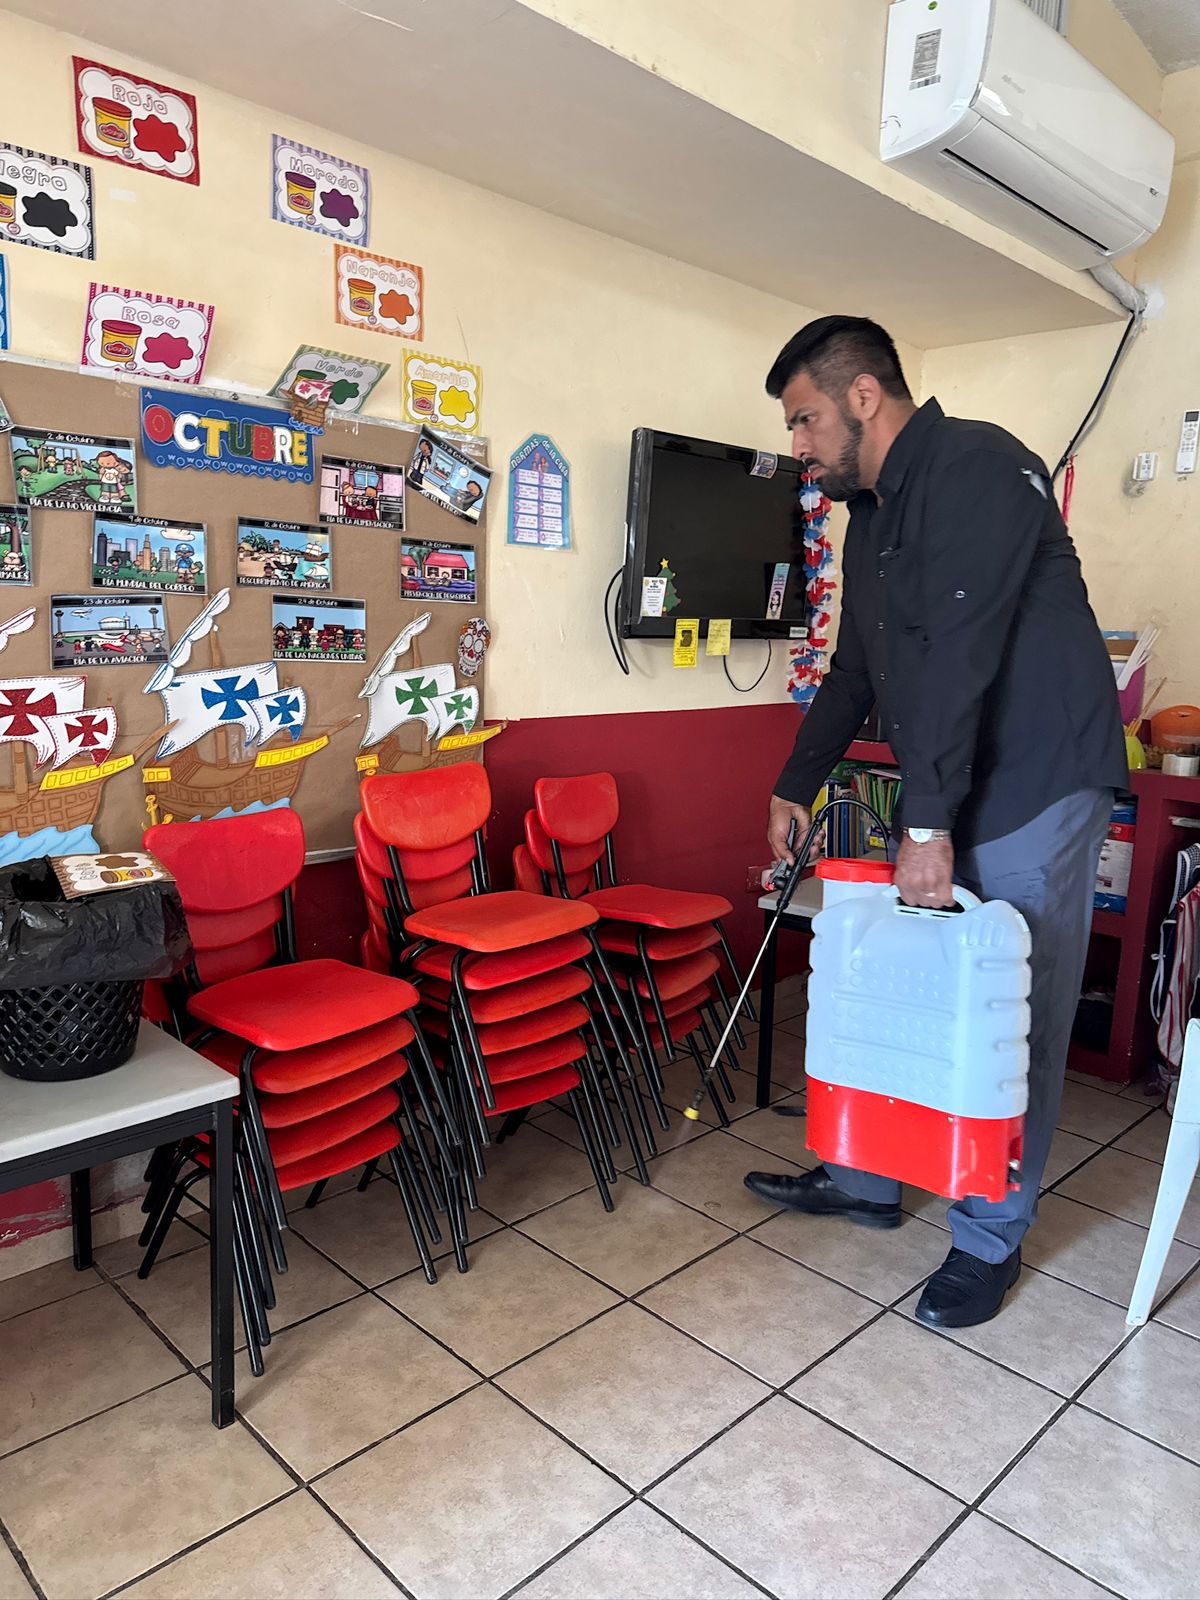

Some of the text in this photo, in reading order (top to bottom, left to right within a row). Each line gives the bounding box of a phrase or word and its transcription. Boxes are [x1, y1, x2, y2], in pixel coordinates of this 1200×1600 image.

[112, 84, 167, 114] Rojo
[290, 157, 358, 192] Morado
[347, 259, 416, 289] Naranja
[122, 306, 180, 329] Rosa
[315, 360, 363, 378] Verde
[415, 365, 468, 387] Amarillo
[66, 434, 95, 444] Octubre
[143, 405, 308, 466] OCTUBRE
[44, 499, 54, 507] DE
[55, 500, 65, 508] LA
[67, 501, 79, 510] NO
[80, 502, 122, 513] VIOLENCIA
[143, 517, 169, 526] Octubre
[279, 523, 300, 531] Octubre
[116, 579, 148, 589] MUNDIAL
[165, 583, 195, 592] CORREO
[239, 577, 290, 587] DESCUBRIMIENTO
[88, 657, 98, 665] DE
